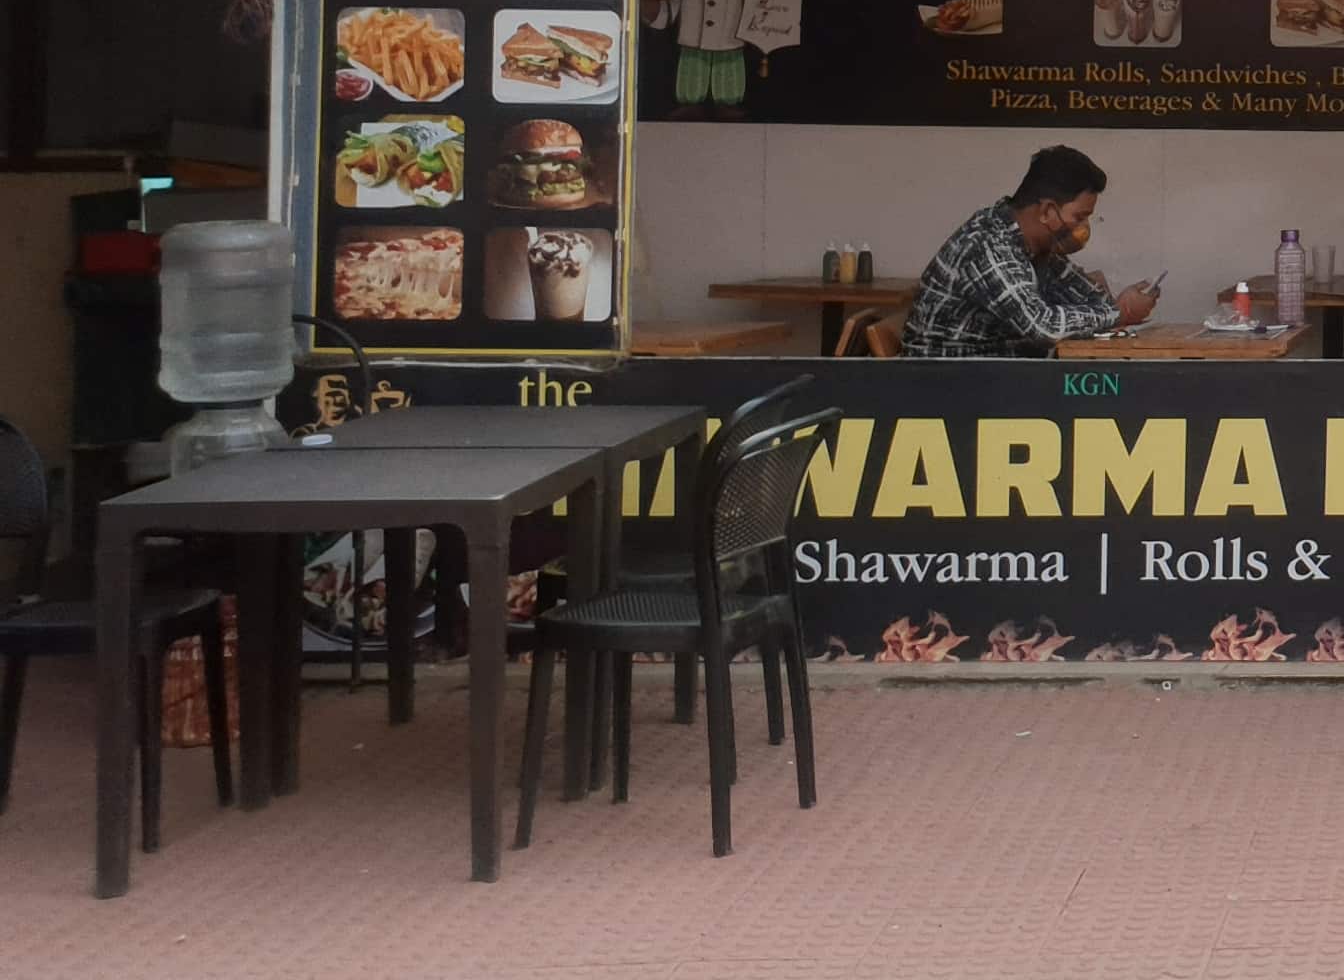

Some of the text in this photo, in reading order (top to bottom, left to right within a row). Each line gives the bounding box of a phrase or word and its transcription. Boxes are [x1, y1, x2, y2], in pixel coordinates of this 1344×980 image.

[946, 59, 1075, 83] Shawarma
[1084, 61, 1152, 86] Rolls,
[1160, 62, 1307, 87] Sandwiches
[990, 89, 1058, 113] Pizza,
[1068, 90, 1193, 117] Beverages
[1201, 91, 1222, 113] &
[1231, 92, 1298, 118] Many
[518, 370, 593, 407] the
[1063, 372, 1120, 396] KGN
[795, 538, 1069, 583] Shawarma
[1140, 537, 1268, 582] Rolls
[1287, 540, 1331, 581] &
